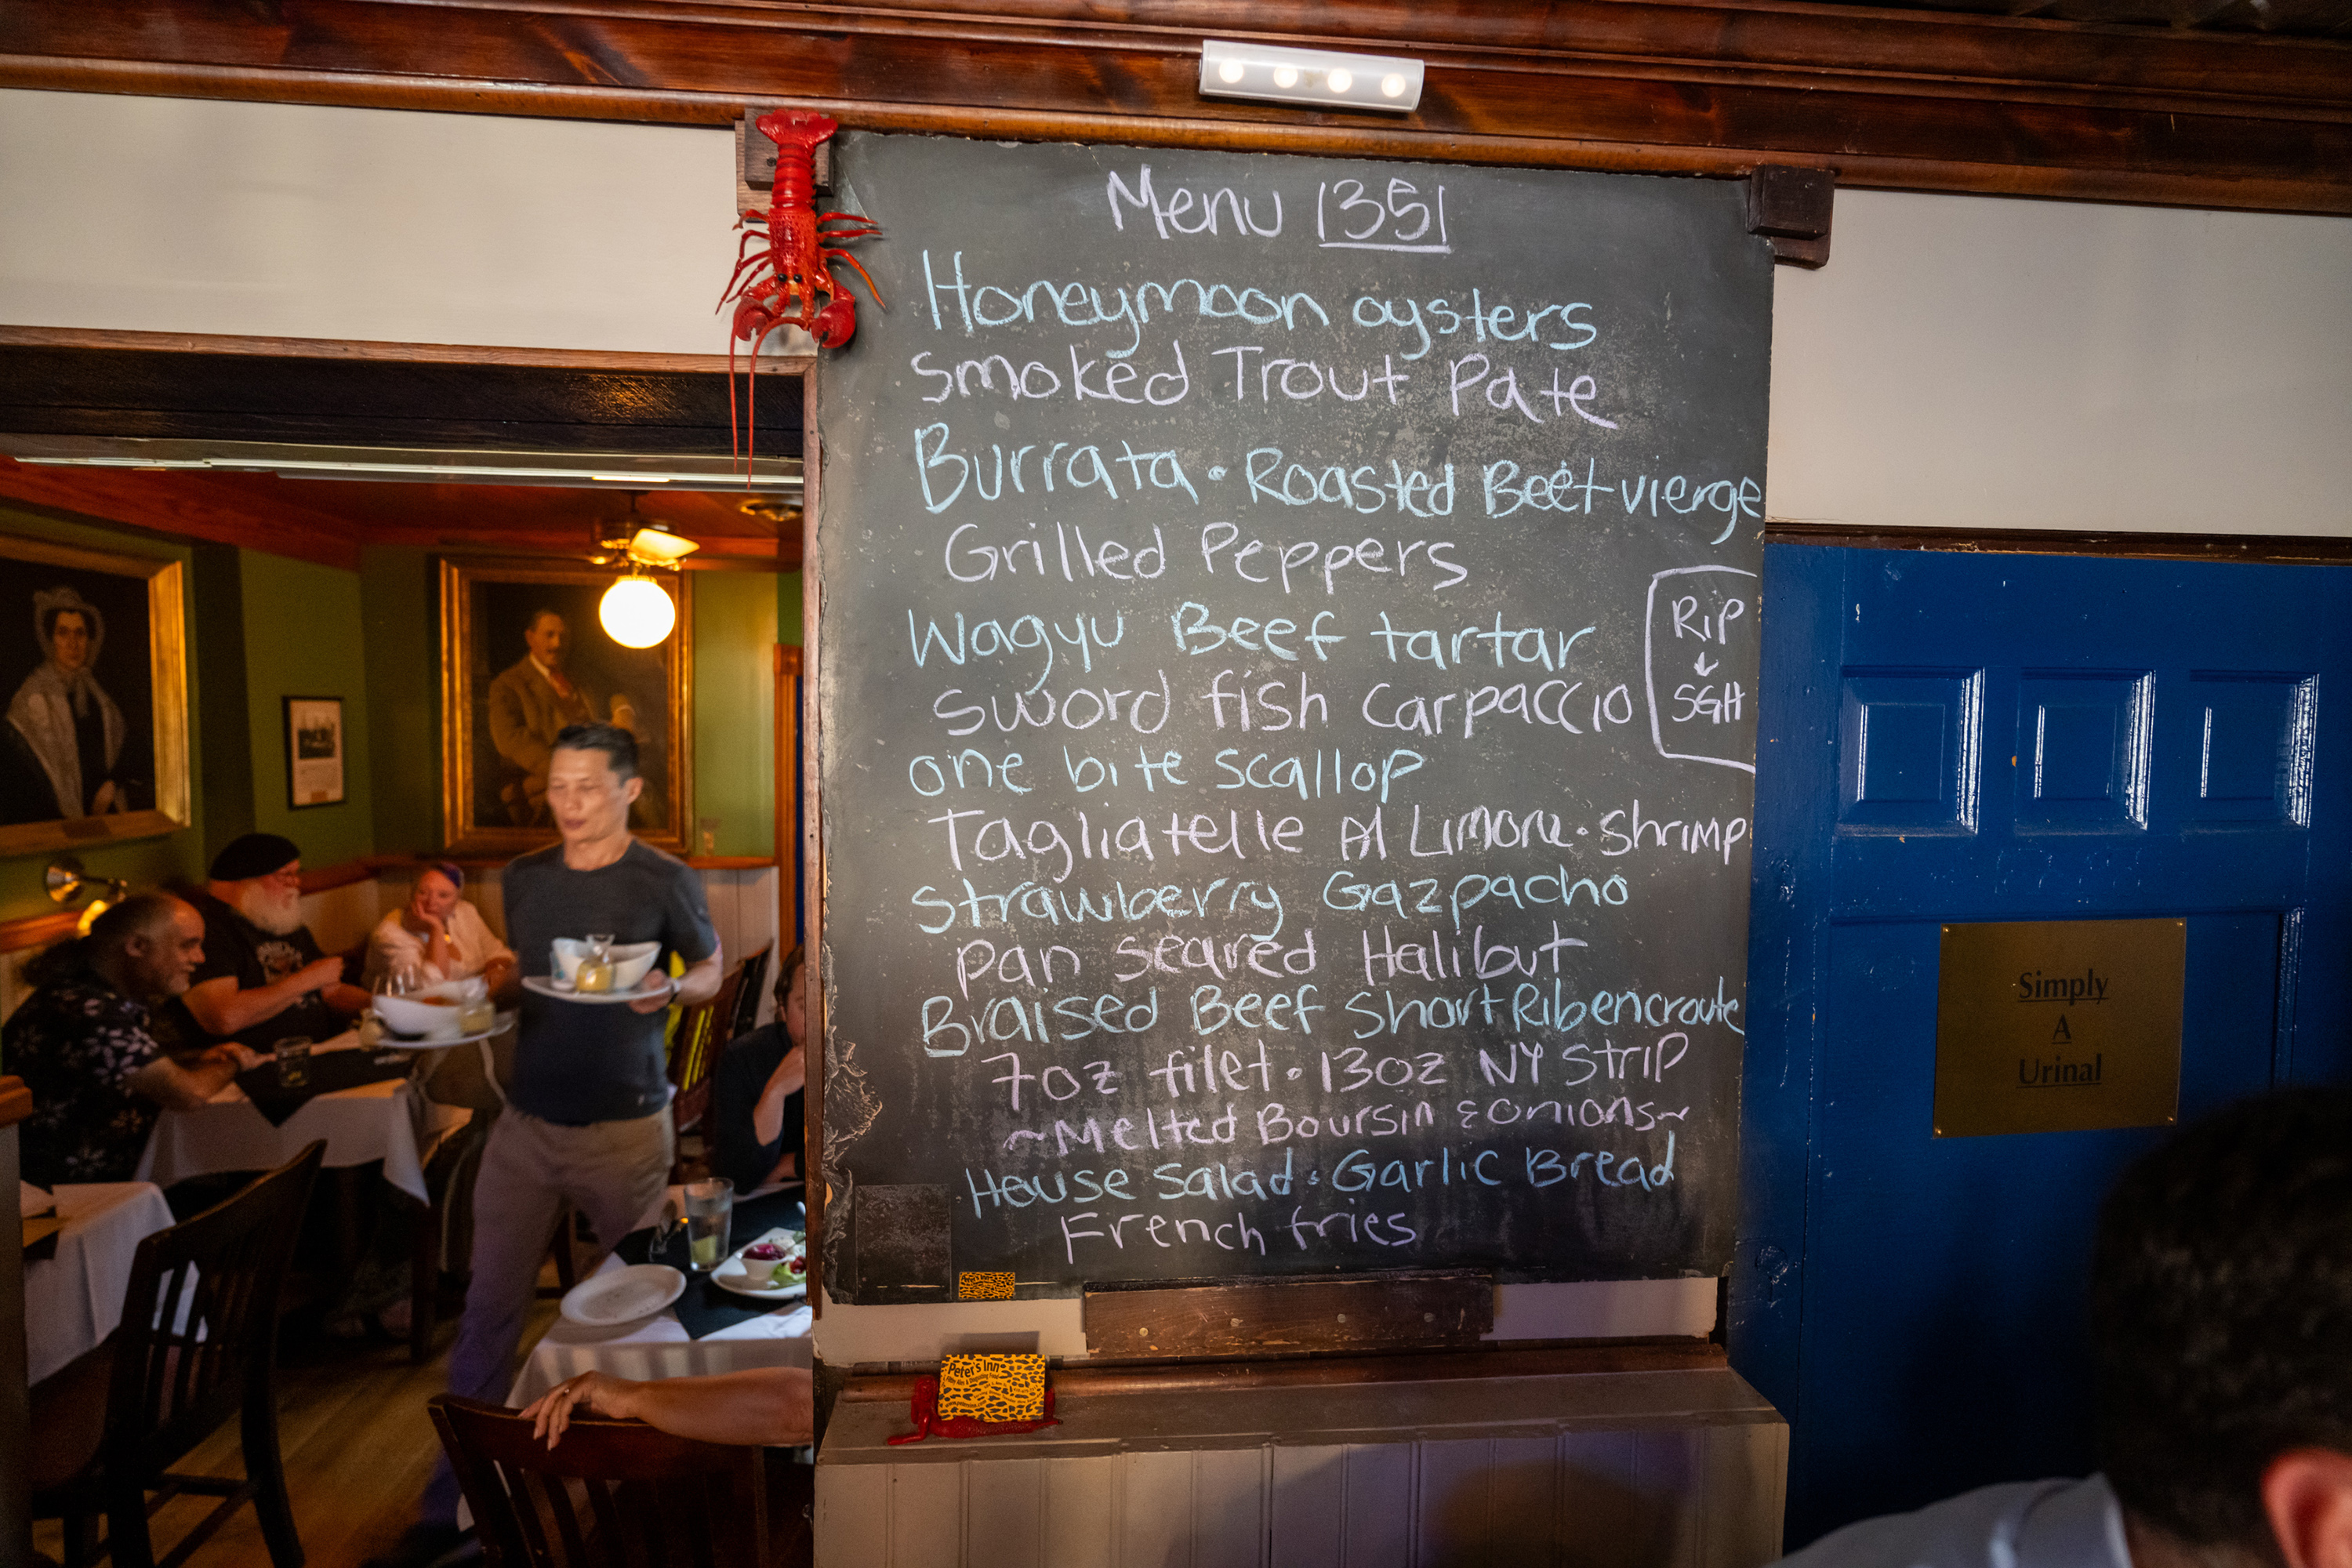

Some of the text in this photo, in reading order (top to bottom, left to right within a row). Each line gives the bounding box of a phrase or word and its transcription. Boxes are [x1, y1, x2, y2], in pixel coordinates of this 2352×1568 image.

[1106, 163, 1283, 239] Menu
[923, 249, 1597, 361] Honeymoon oysters
[1211, 345, 1410, 405] Trout
[1451, 352, 1619, 429] Pate
[915, 422, 1200, 514] Burrata
[1247, 447, 1454, 517] Roasted
[945, 521, 1468, 594] Grilled Peppers
[908, 601, 1597, 696] Wagyu Beef tartar
[1200, 669, 1330, 732] fish
[1671, 681, 1746, 724] SGH
[1063, 744, 1189, 793] bite
[927, 802, 1305, 884] Tagliatelle
[1323, 864, 1629, 931] Gazpacho
[1362, 920, 1588, 987] Halibut
[2019, 968, 2109, 1006] Simply
[921, 985, 1160, 1058] Braised
[1190, 983, 1327, 1036] Beef
[2052, 1014, 2072, 1040] A
[1479, 1040, 1544, 1087] NY
[2018, 1053, 2103, 1085] Urinal
[1526, 1129, 1675, 1192] Bread
[1061, 1211, 1266, 1265] French
[948, 1359, 1000, 1378] Peter's Inn
